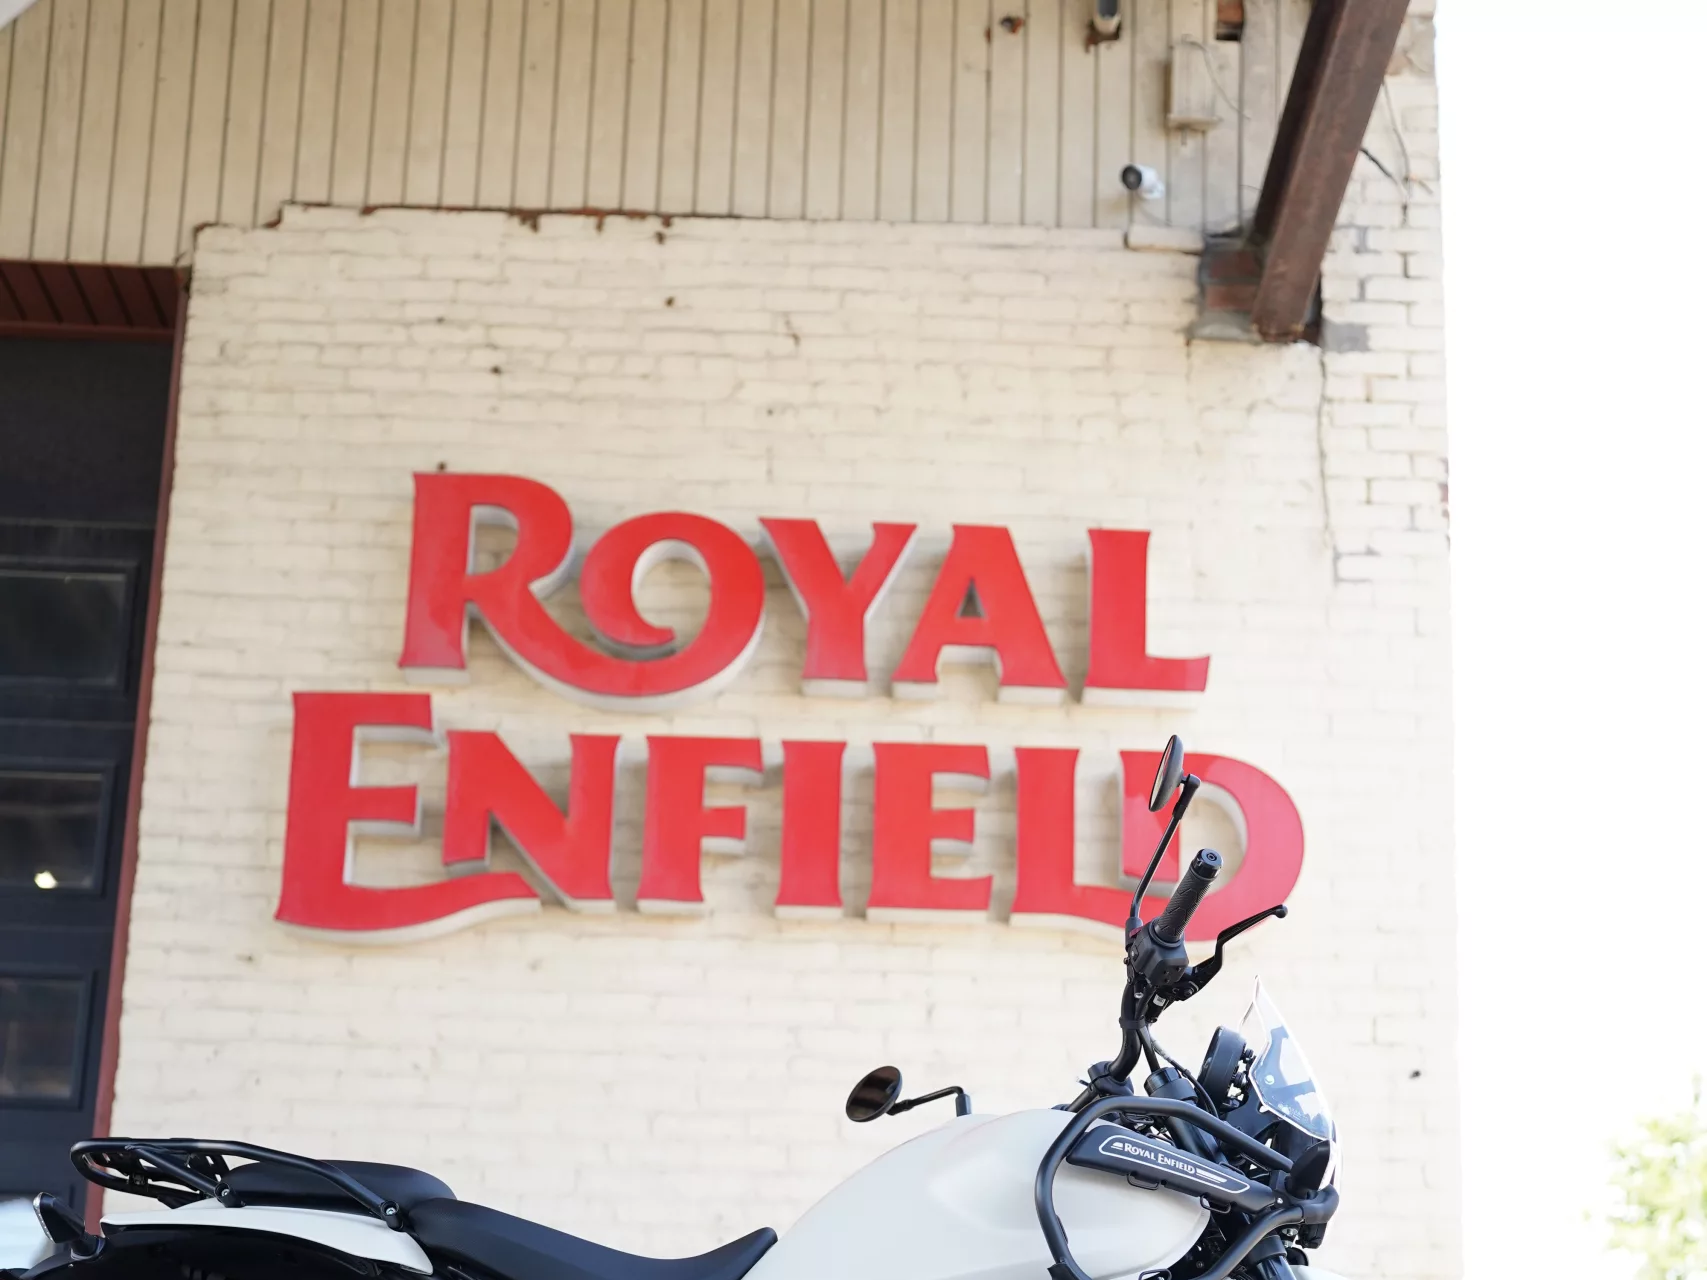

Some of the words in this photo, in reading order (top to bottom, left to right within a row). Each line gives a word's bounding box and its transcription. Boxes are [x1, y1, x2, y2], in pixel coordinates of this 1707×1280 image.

[400, 471, 1211, 702] ROYAL
[274, 691, 1305, 942] ENFIELD
[1124, 1142, 1156, 1161] ROYAL
[1157, 1153, 1196, 1174] ENFIELD
